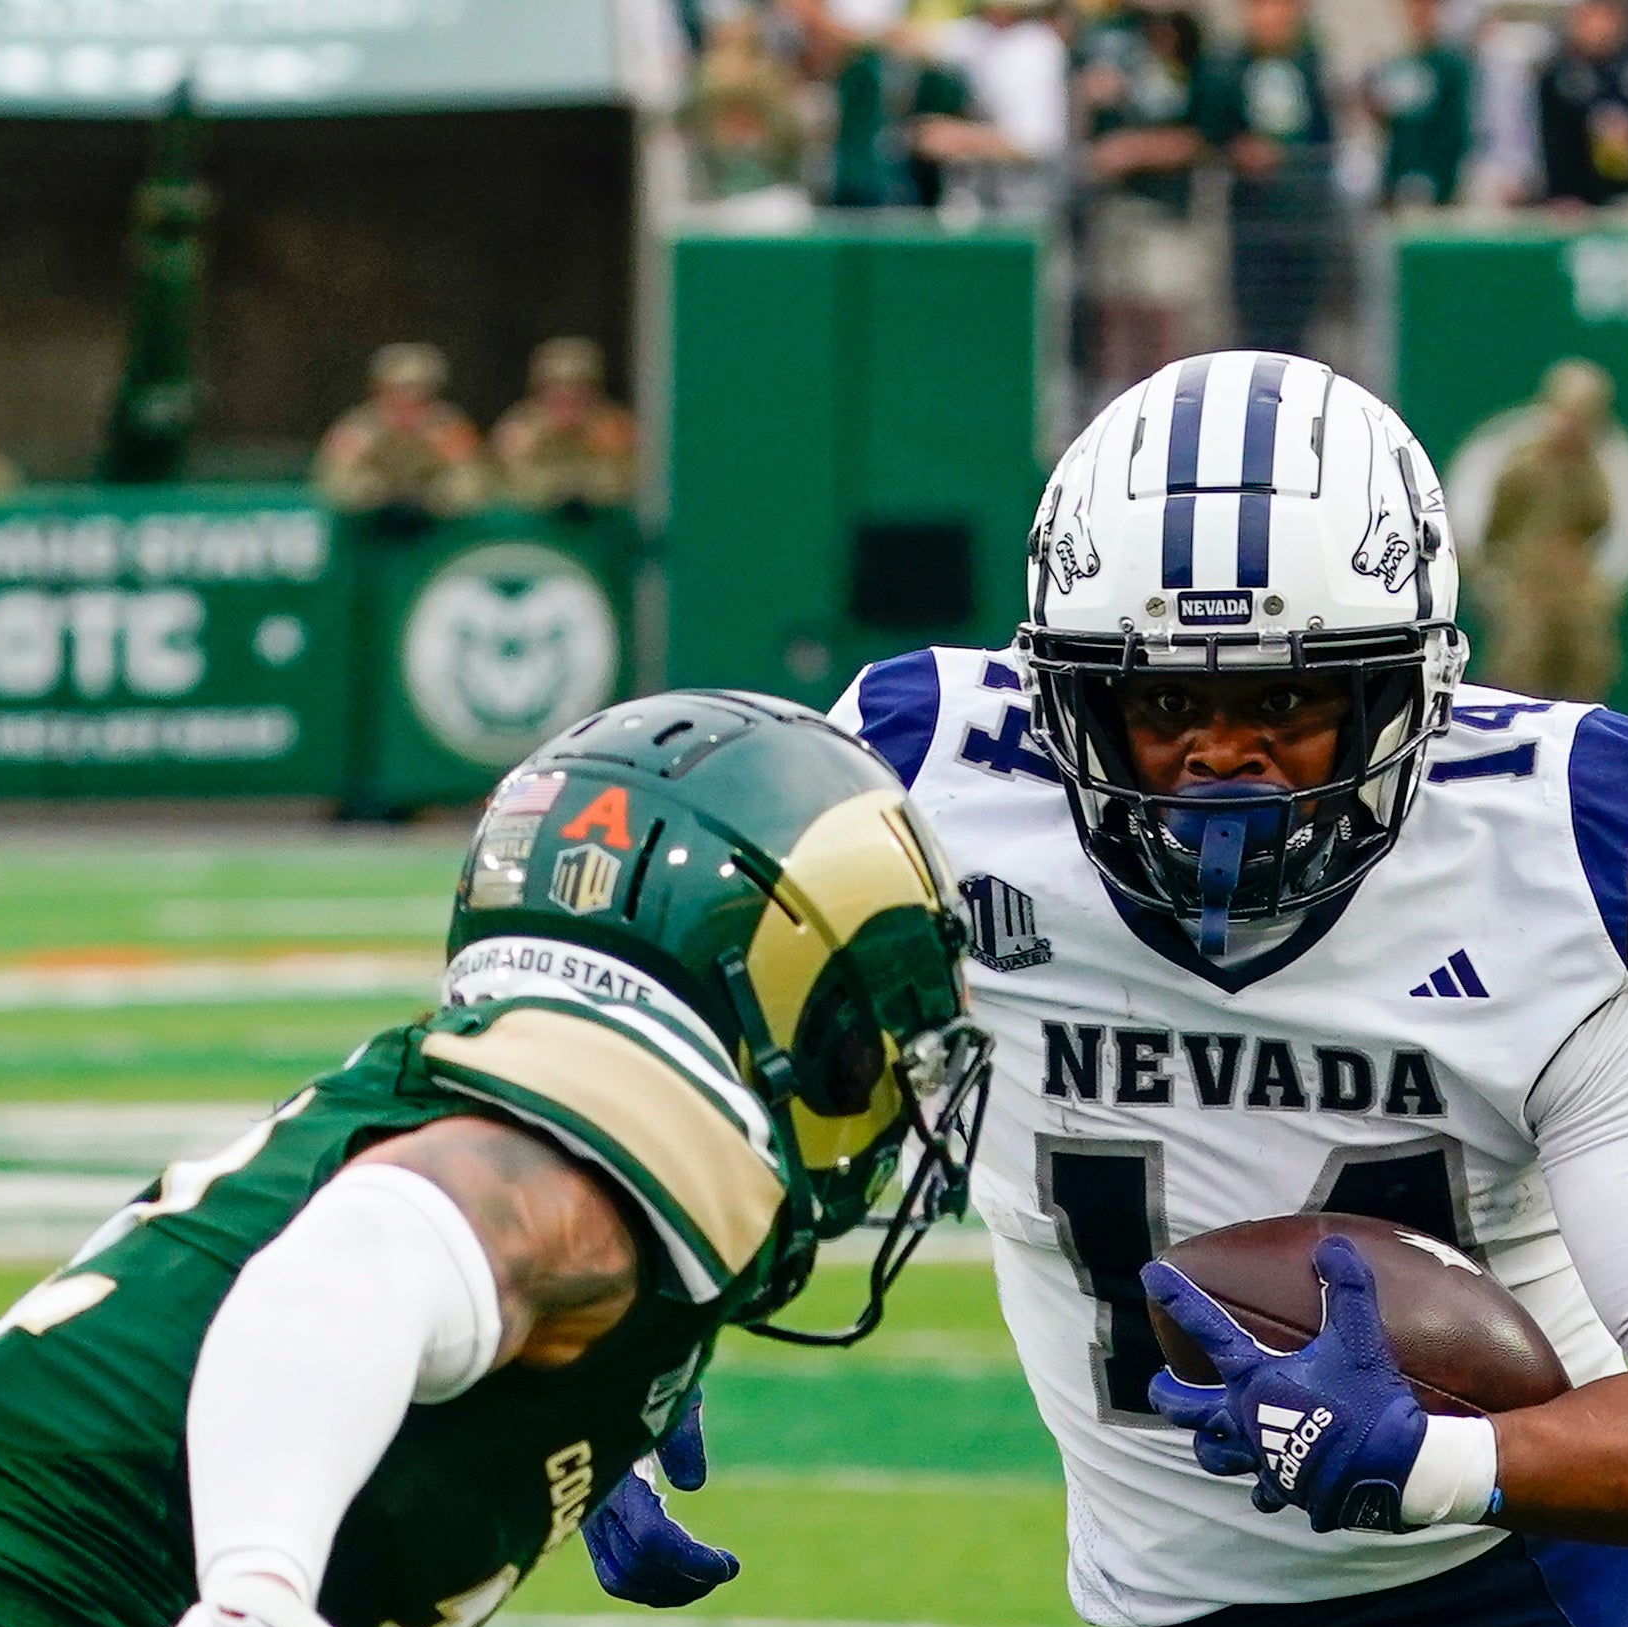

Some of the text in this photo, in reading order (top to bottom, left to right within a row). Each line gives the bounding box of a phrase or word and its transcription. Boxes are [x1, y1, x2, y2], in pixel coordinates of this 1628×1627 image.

[1181, 599, 1250, 616] NEVADA
[561, 786, 632, 851] A
[561, 957, 653, 1003] STATE
[1041, 1019, 1449, 1118] NEVADA
[1279, 1406, 1334, 1491] adidas
